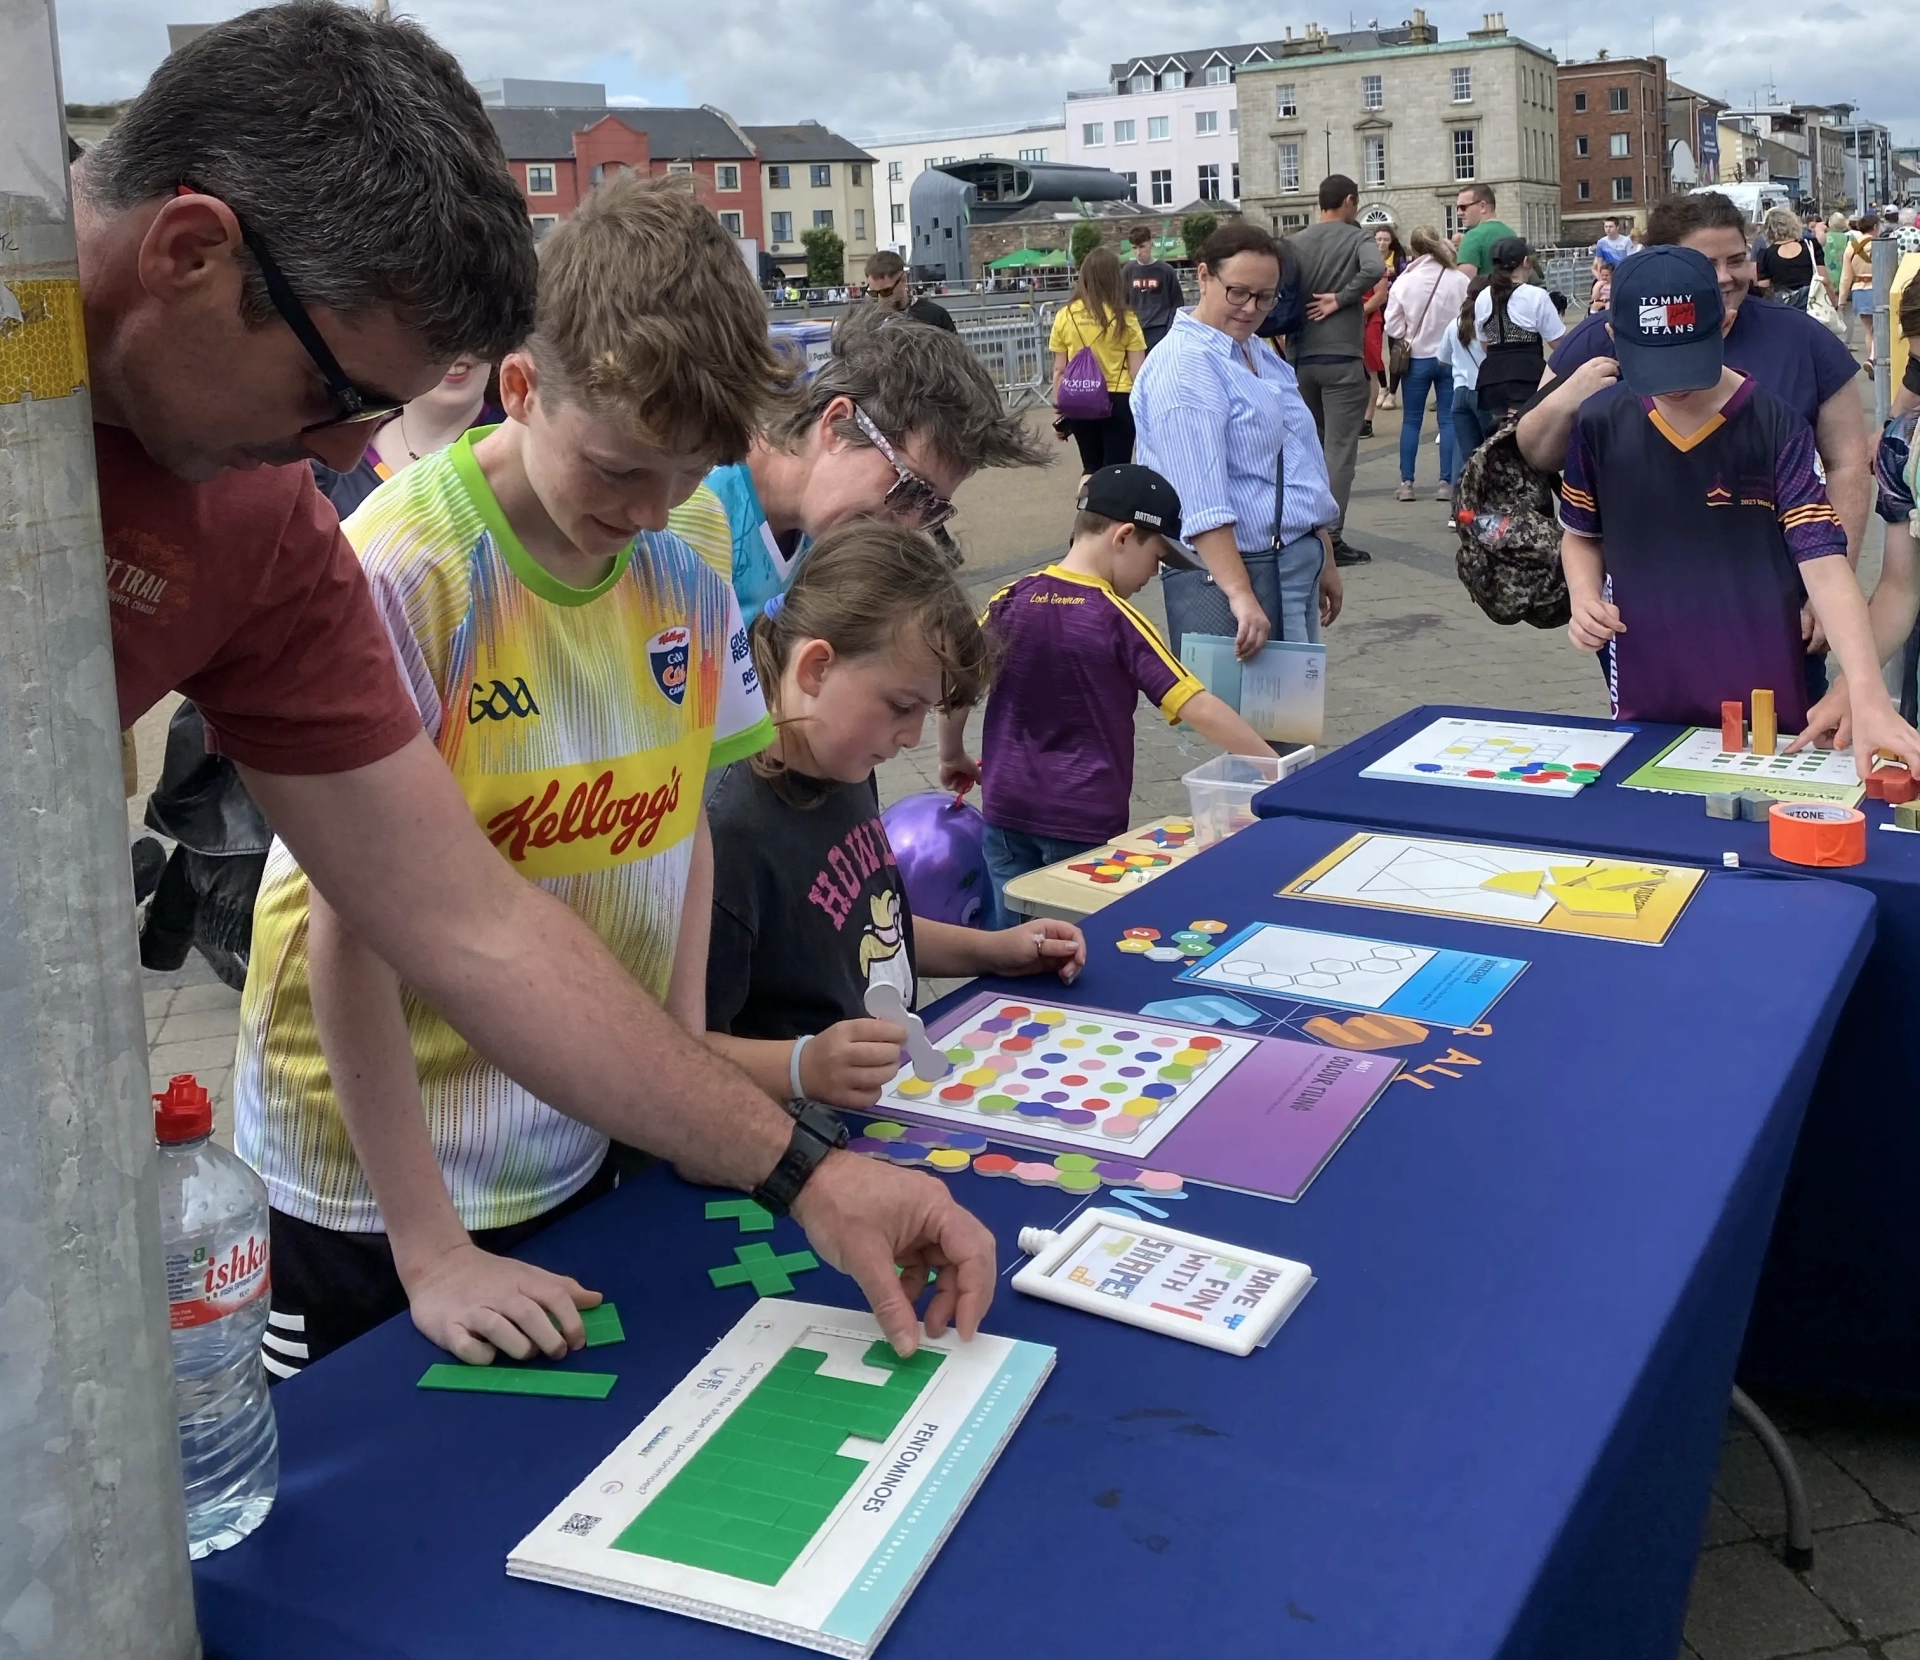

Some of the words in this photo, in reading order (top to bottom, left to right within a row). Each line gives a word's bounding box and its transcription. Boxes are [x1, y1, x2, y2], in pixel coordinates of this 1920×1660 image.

[1133, 280, 1158, 288] AIR
[1641, 295, 1692, 305] TOMMY
[1642, 324, 1694, 334] JEANS
[1134, 511, 1162, 526] BATMAN
[120, 564, 168, 603] TRAIL
[131, 600, 157, 615] CANADA
[487, 766, 683, 862] Kellogg's
[1311, 1056, 1353, 1086] COLOUR
[1394, 1047, 1482, 1090] ALL
[1289, 1086, 1326, 1112] TILING
[203, 1236, 267, 1293] ishka
[1161, 1253, 1212, 1292] WITH
[1184, 1277, 1230, 1311] FUN
[1232, 1269, 1282, 1309] HAVE
[735, 1374, 749, 1388] you
[748, 1362, 764, 1375] Can
[716, 1396, 732, 1408] the
[727, 1388, 741, 1397] fill
[971, 1373, 1013, 1429] DEVELOPING
[700, 1408, 720, 1429] shape
[684, 1428, 701, 1444] with
[862, 1422, 939, 1514] PENTOMINOES
[859, 1529, 909, 1592] STRATEGIES
